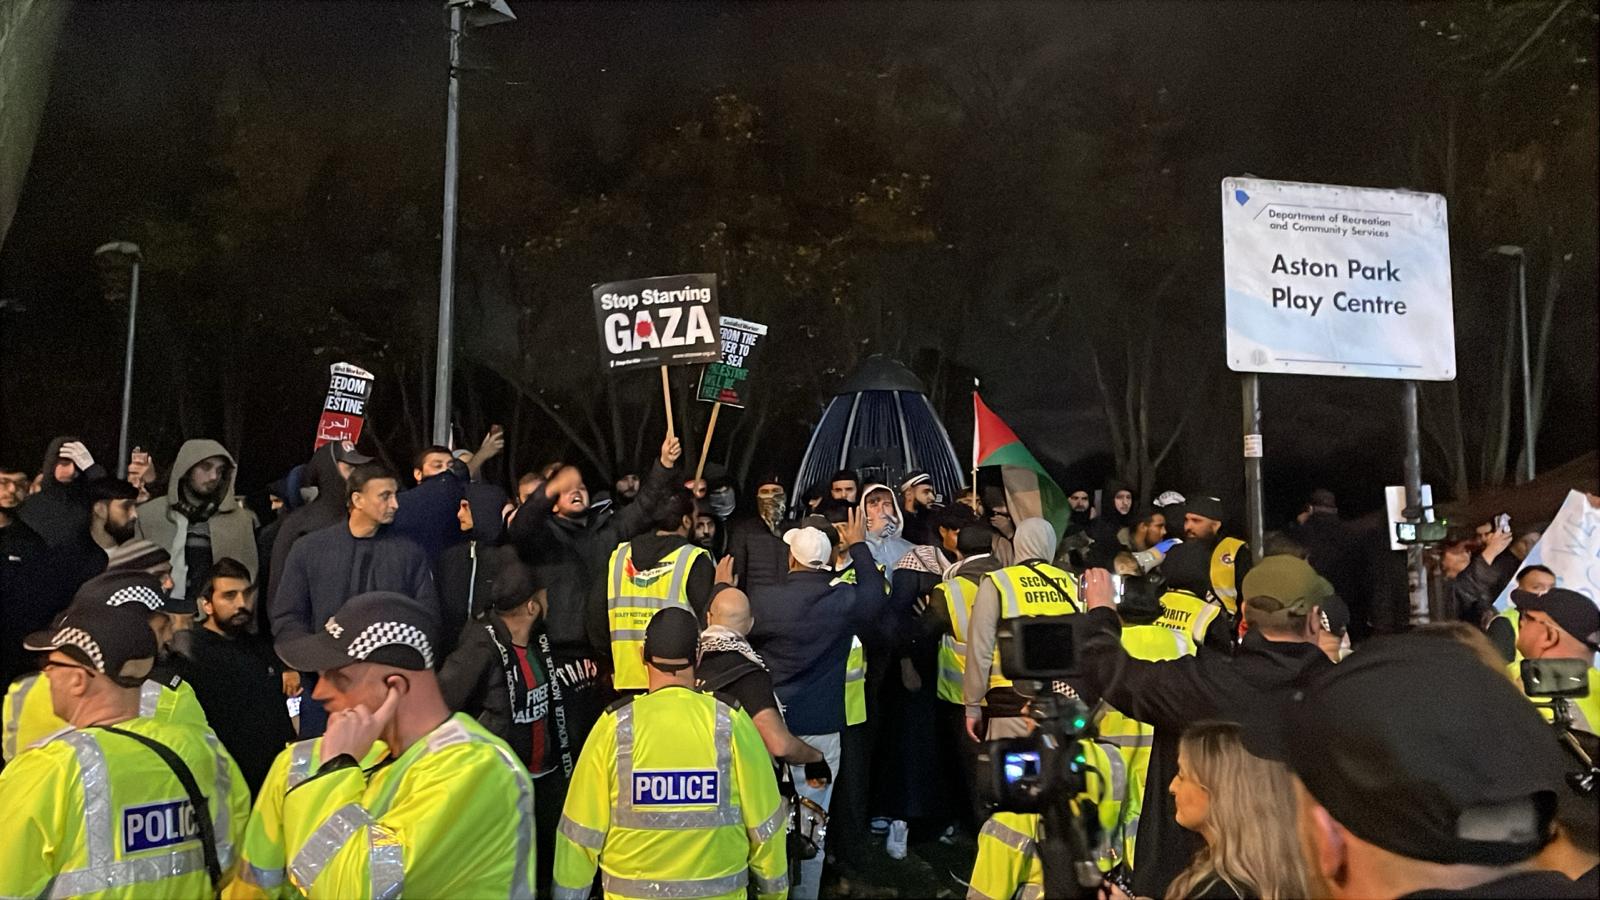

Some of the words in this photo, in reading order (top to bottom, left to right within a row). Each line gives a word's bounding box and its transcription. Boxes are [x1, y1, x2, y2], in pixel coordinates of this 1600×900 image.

[1269, 209, 1326, 224] Department
[1328, 212, 1339, 223] of
[1342, 214, 1391, 227] Recreation
[1270, 221, 1288, 231] and
[1292, 222, 1348, 237] Community
[1351, 226, 1390, 238] Services
[1271, 253, 1338, 278] Aston
[1348, 259, 1401, 282] Park
[600, 292, 639, 311] Stop
[641, 285, 711, 306] Starving
[1272, 286, 1323, 317] Play
[1333, 291, 1407, 315] Centre
[604, 305, 715, 355] GAZA
[742, 332, 758, 346] THE
[721, 340, 738, 354] VER
[738, 343, 750, 357] TO
[726, 354, 744, 368] SEA
[330, 375, 367, 394] EEDOM
[326, 395, 365, 415] ESTINE
[1020, 576, 1067, 588] SECUTY
[1163, 607, 1192, 622] URITY
[546, 656, 562, 700] MONCLER
[555, 704, 569, 748] MONCLER
[636, 775, 715, 801] POLICE
[127, 804, 197, 847] POLIC
